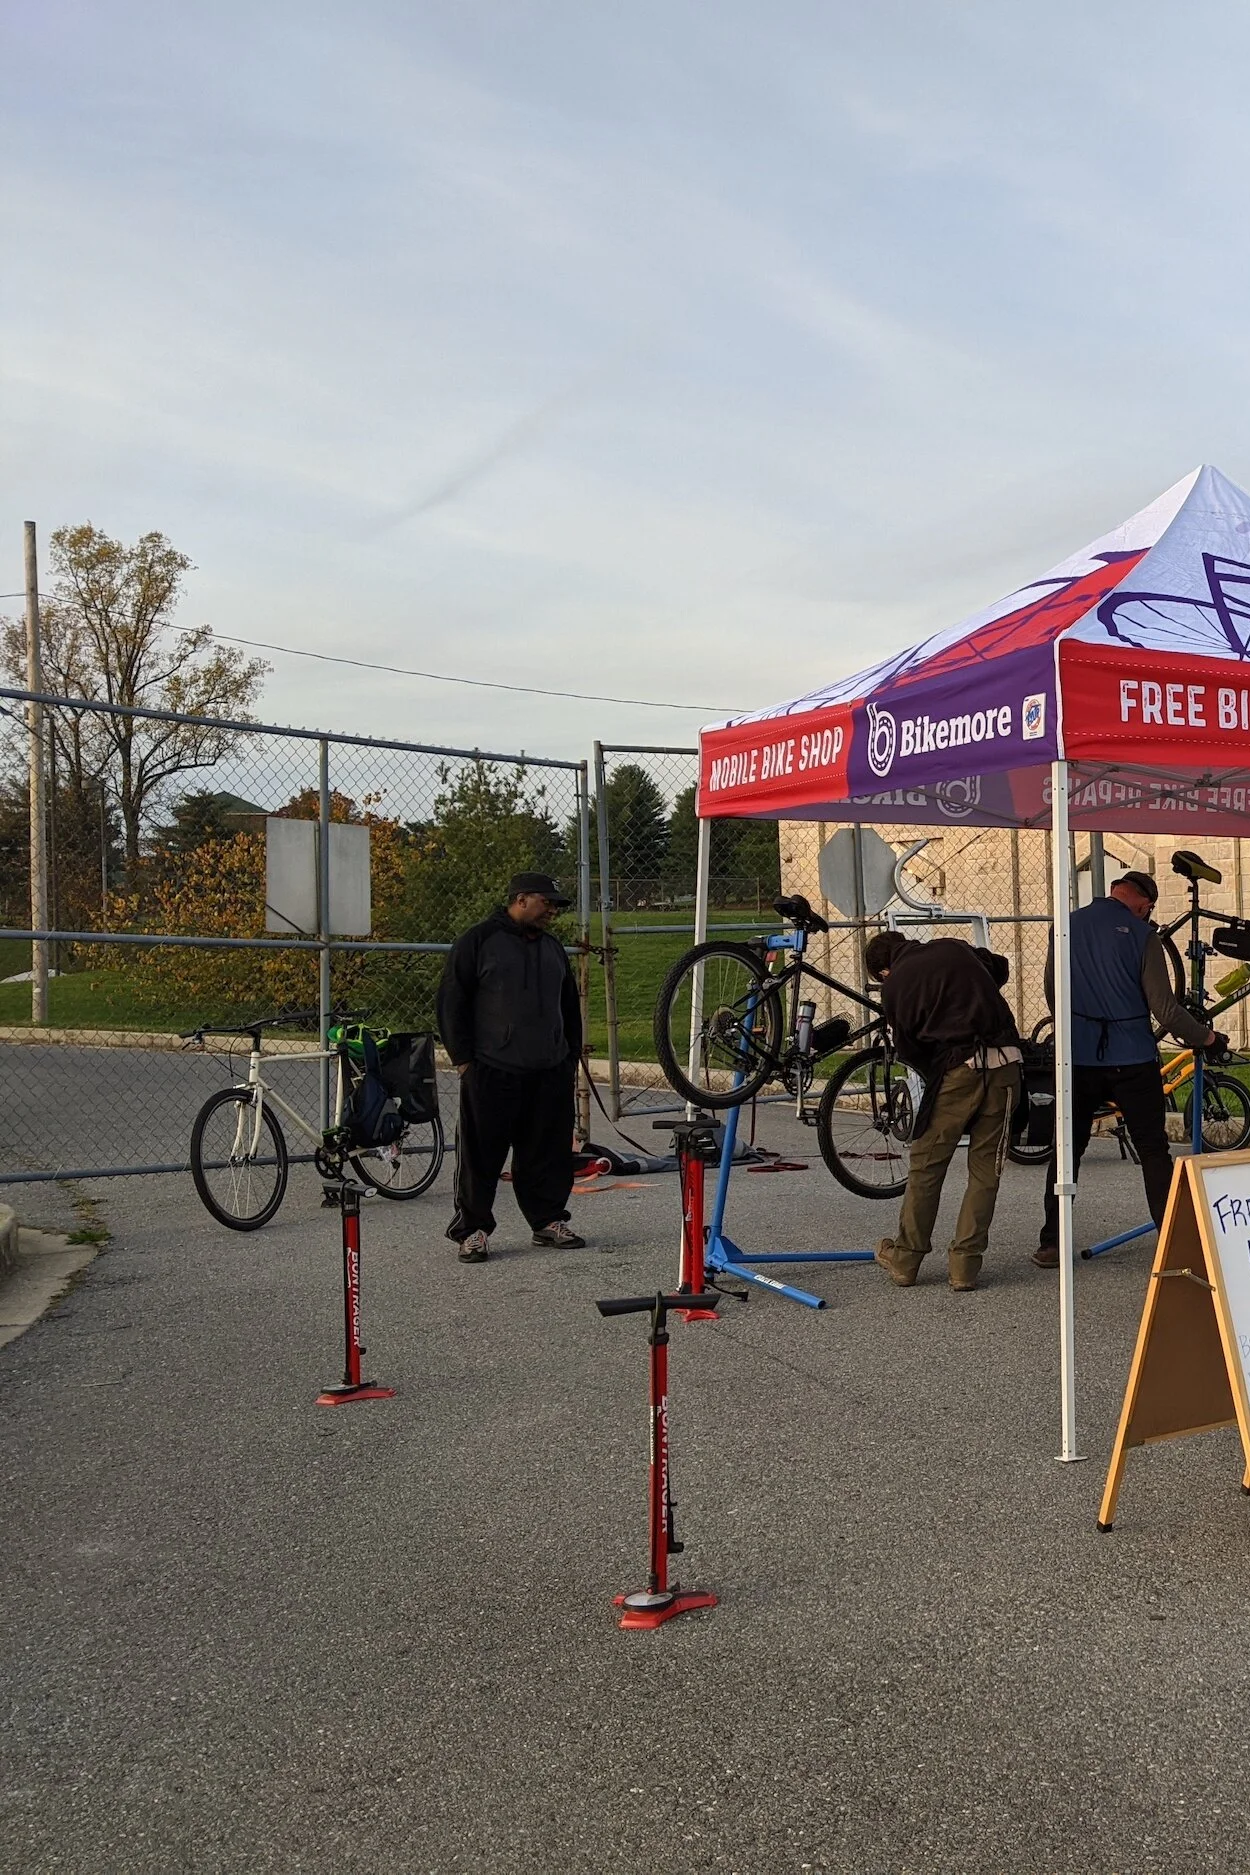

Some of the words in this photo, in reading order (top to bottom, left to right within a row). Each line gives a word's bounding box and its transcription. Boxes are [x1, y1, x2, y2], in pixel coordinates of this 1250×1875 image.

[1119, 679, 1206, 727] FREE
[900, 705, 1012, 757] Bikemore
[709, 749, 758, 792] MOBILE
[761, 739, 795, 780] BIKE
[798, 726, 843, 771] SHOP
